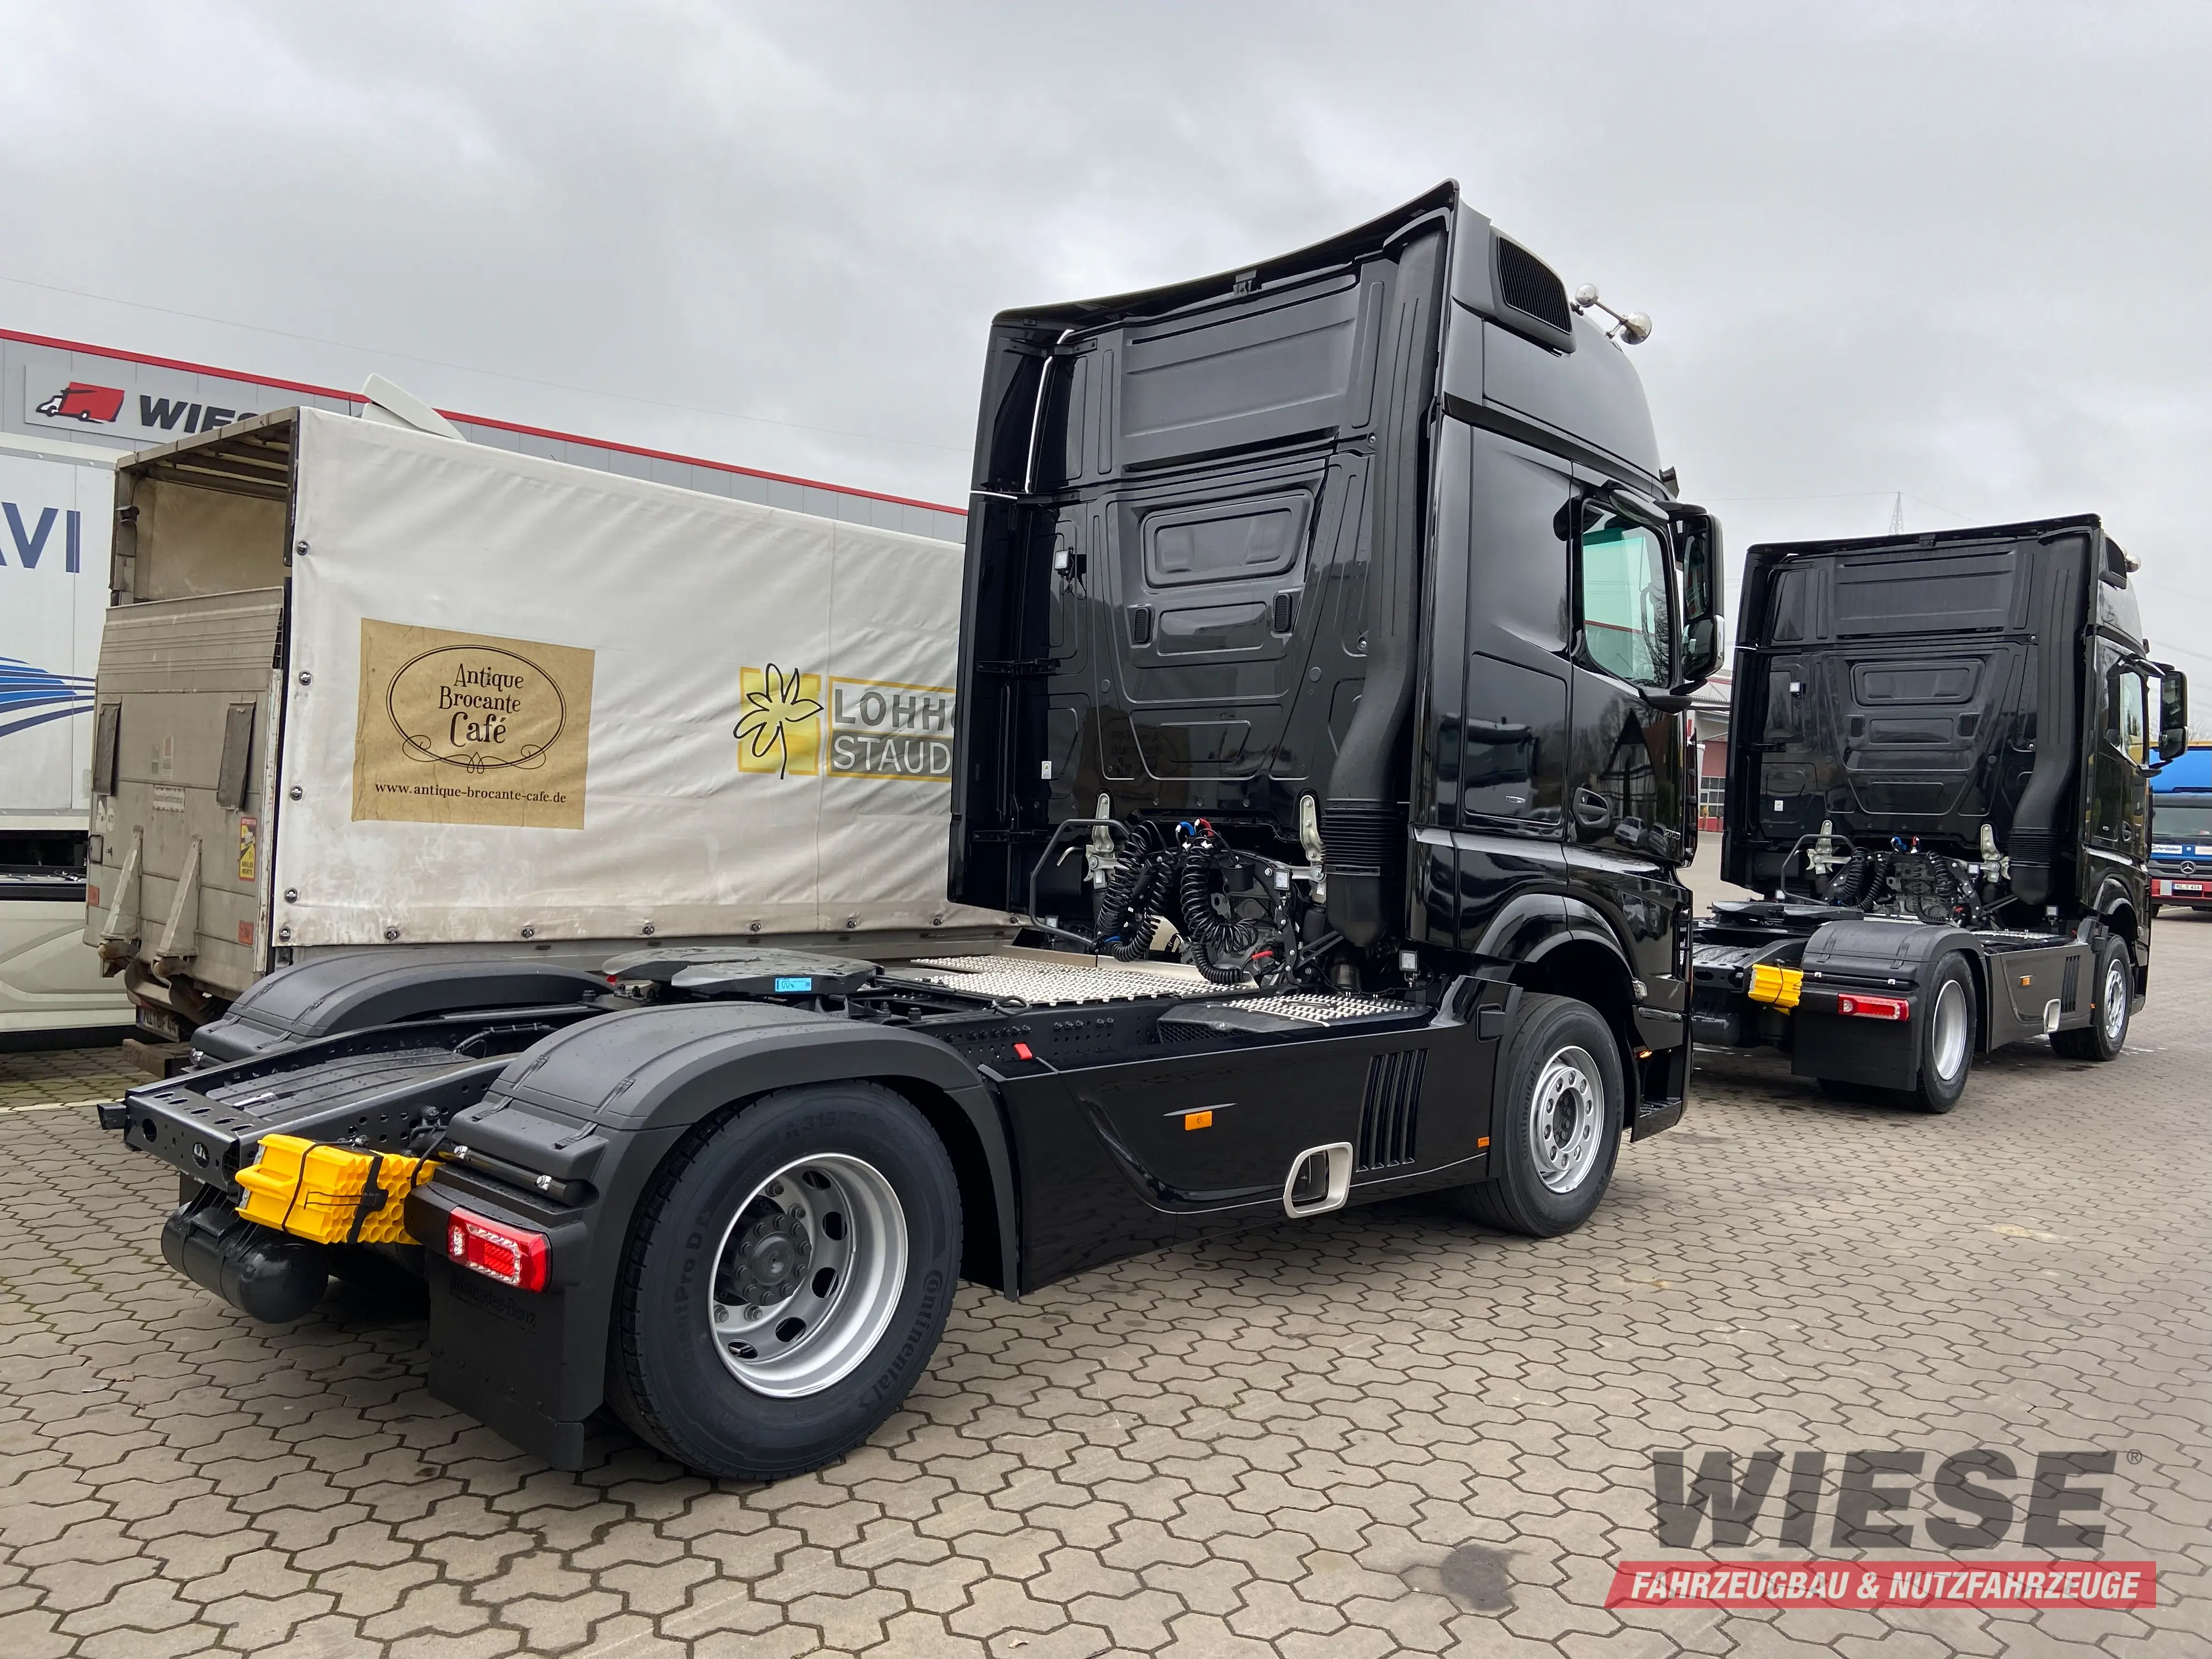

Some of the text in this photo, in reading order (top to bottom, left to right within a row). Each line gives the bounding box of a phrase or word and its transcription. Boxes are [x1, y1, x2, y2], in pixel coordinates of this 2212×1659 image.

[0, 501, 80, 573] VI
[453, 663, 524, 692] Antique
[438, 685, 522, 714] Brocante
[834, 689, 955, 731] LOHH
[450, 712, 507, 748] Café
[833, 736, 951, 775] STAUD
[375, 782, 567, 804] www.antique-brocante-cafe.de
[871, 1269, 943, 1400] Continental
